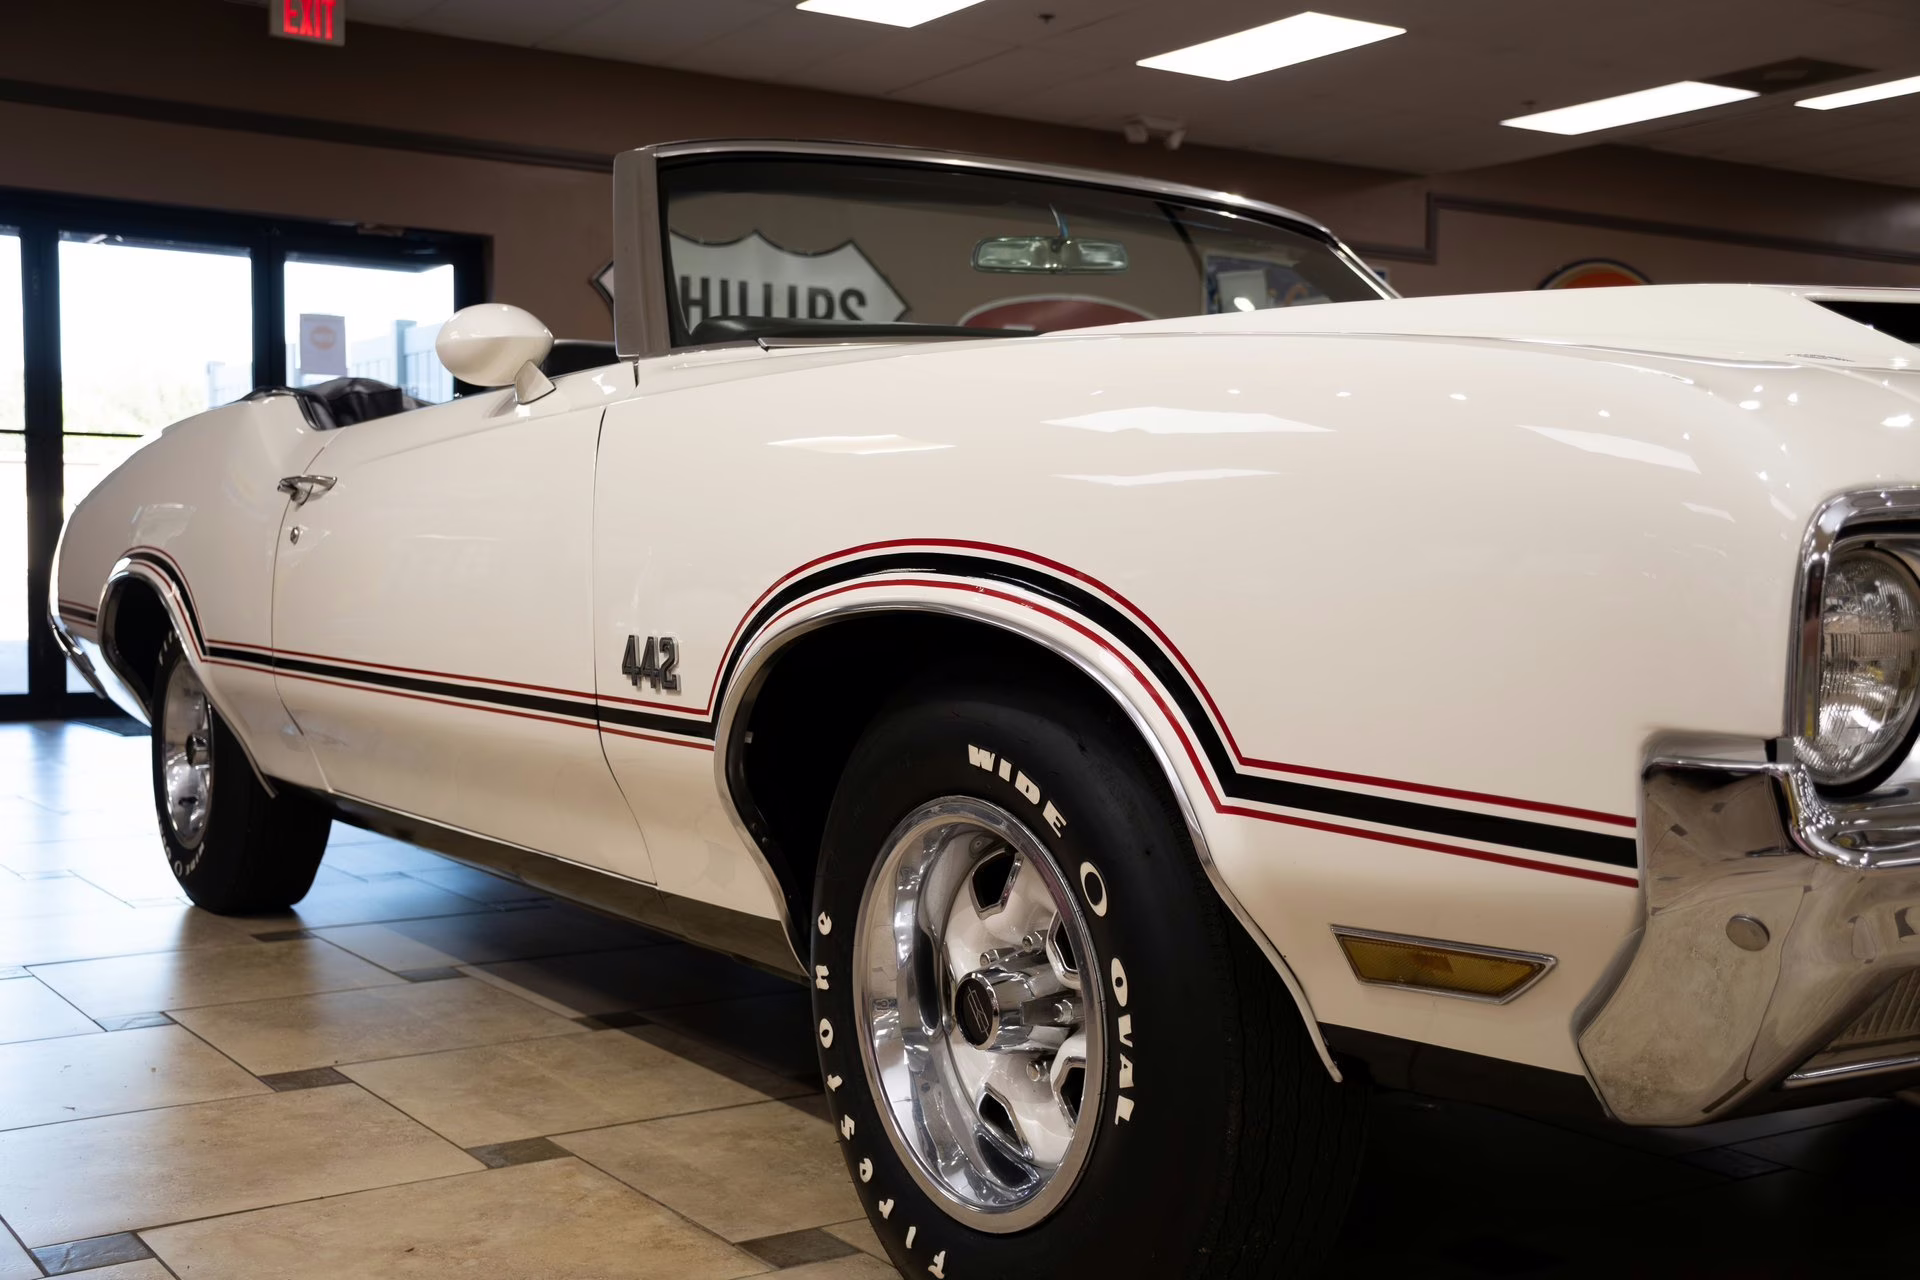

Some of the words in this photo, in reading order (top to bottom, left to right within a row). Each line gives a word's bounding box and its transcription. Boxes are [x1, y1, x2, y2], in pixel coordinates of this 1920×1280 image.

[283, 0, 337, 40] EXIT
[679, 275, 868, 322] HILLIPS
[621, 634, 682, 693] 442
[967, 743, 1067, 838] WIDE
[1110, 957, 1135, 1126] OVAL
[815, 911, 946, 1279] Firestone
